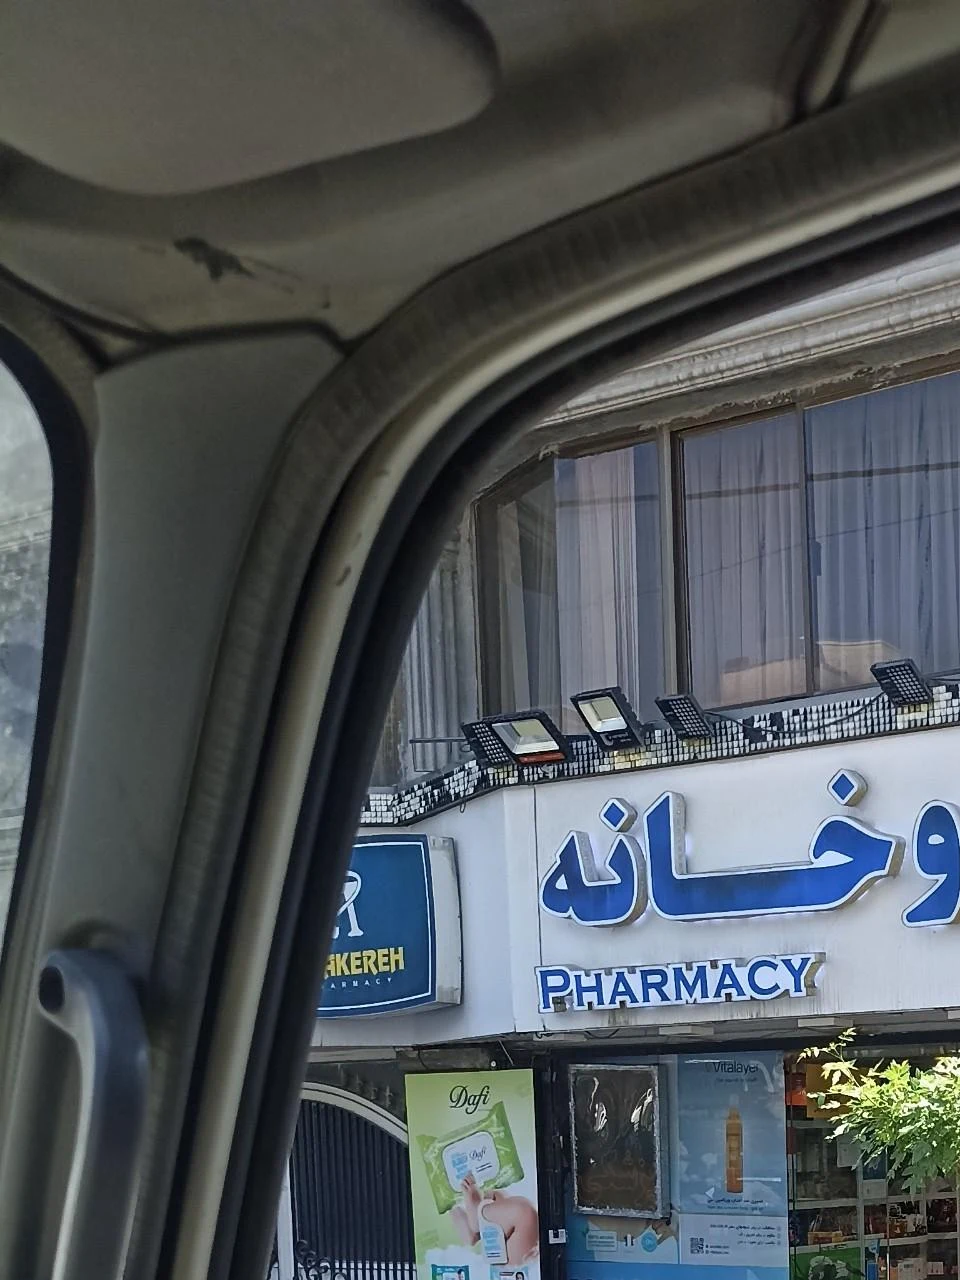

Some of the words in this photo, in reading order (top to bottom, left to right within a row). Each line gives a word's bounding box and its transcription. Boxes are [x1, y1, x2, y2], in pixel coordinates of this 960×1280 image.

[324, 946, 405, 979] AKEREH
[329, 977, 393, 989] ARMACY
[538, 953, 818, 1014] PHARMACY
[449, 1085, 491, 1115] Dafi
